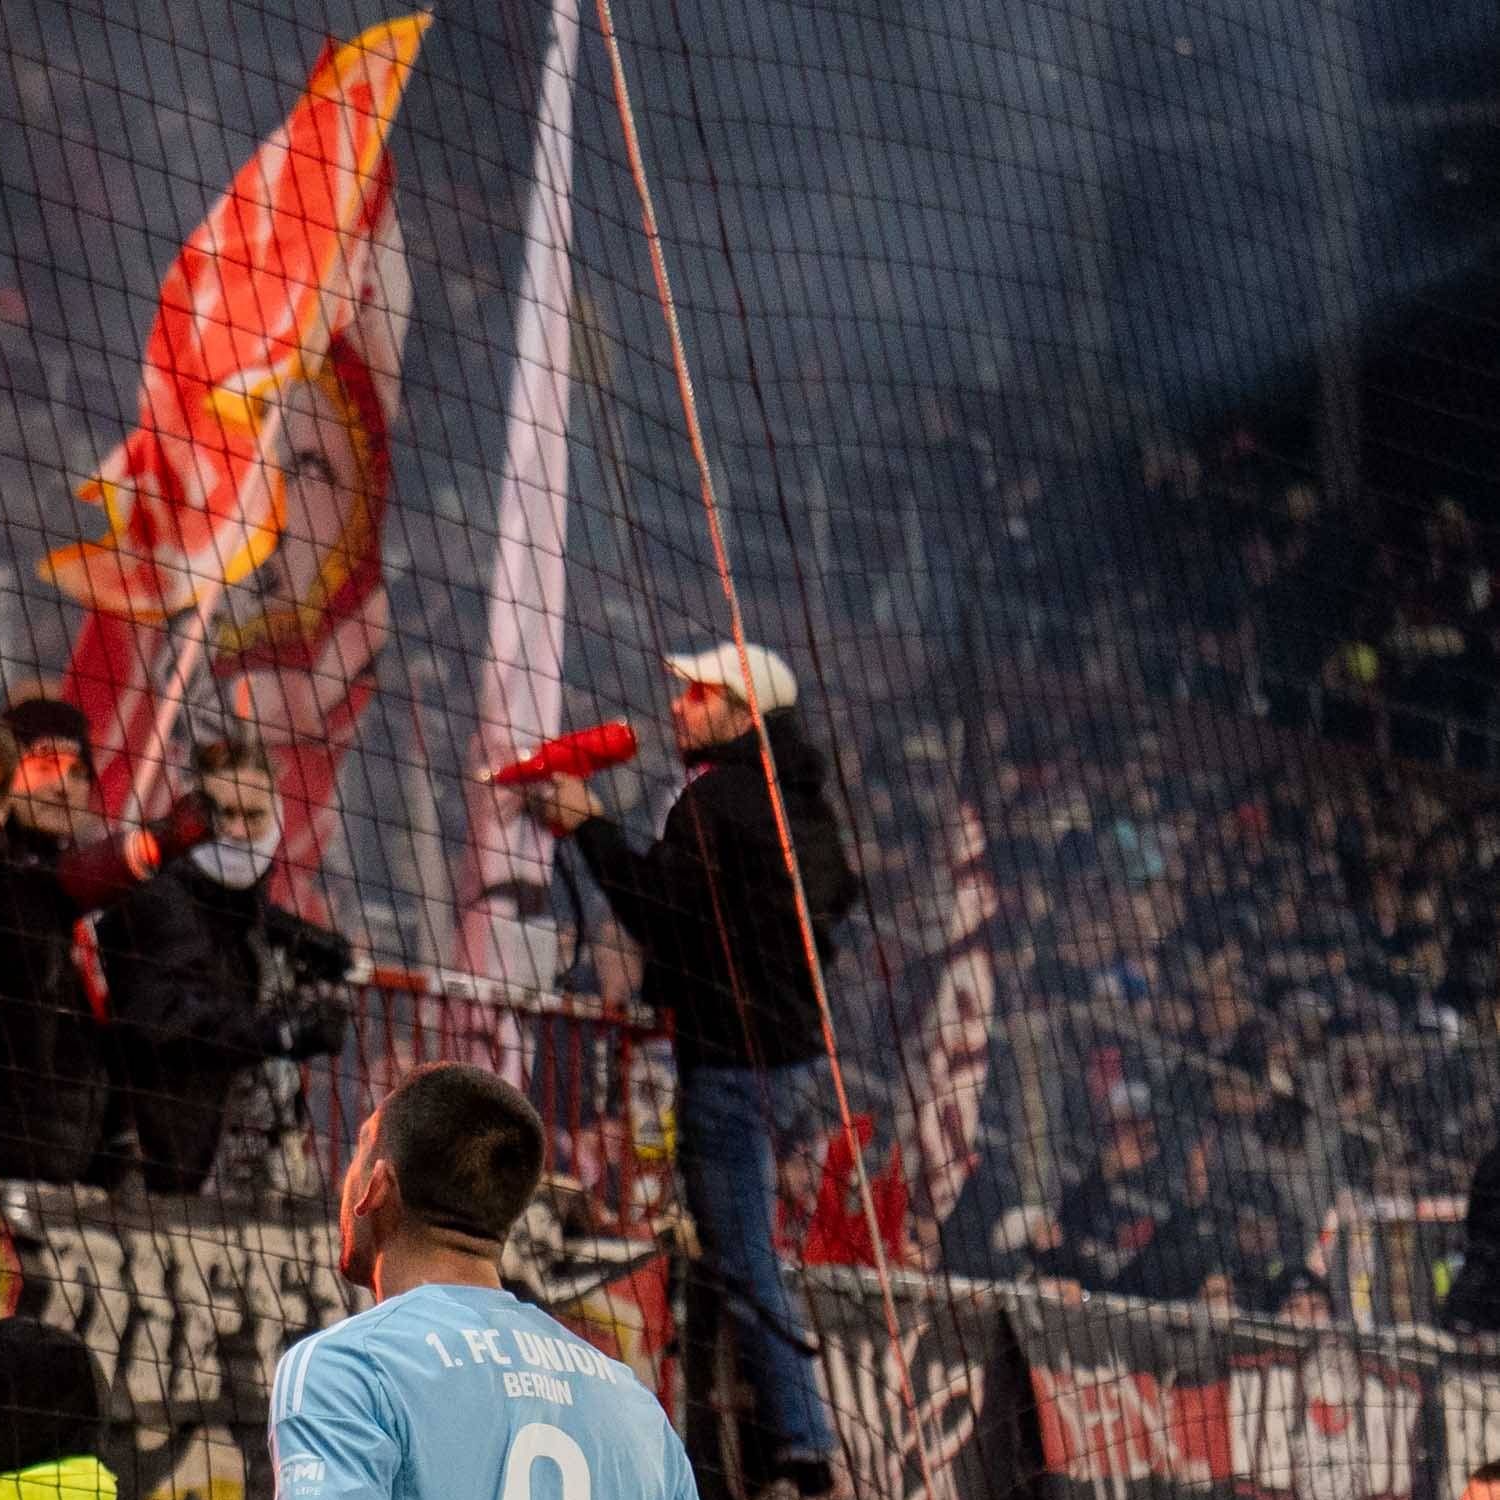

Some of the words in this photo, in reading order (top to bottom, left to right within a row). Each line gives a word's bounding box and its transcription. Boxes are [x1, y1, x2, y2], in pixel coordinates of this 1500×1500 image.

[425, 1332, 463, 1368] 1.
[460, 1328, 513, 1367] FC
[511, 1328, 618, 1385] UNION
[502, 1371, 574, 1407] BERLIN
